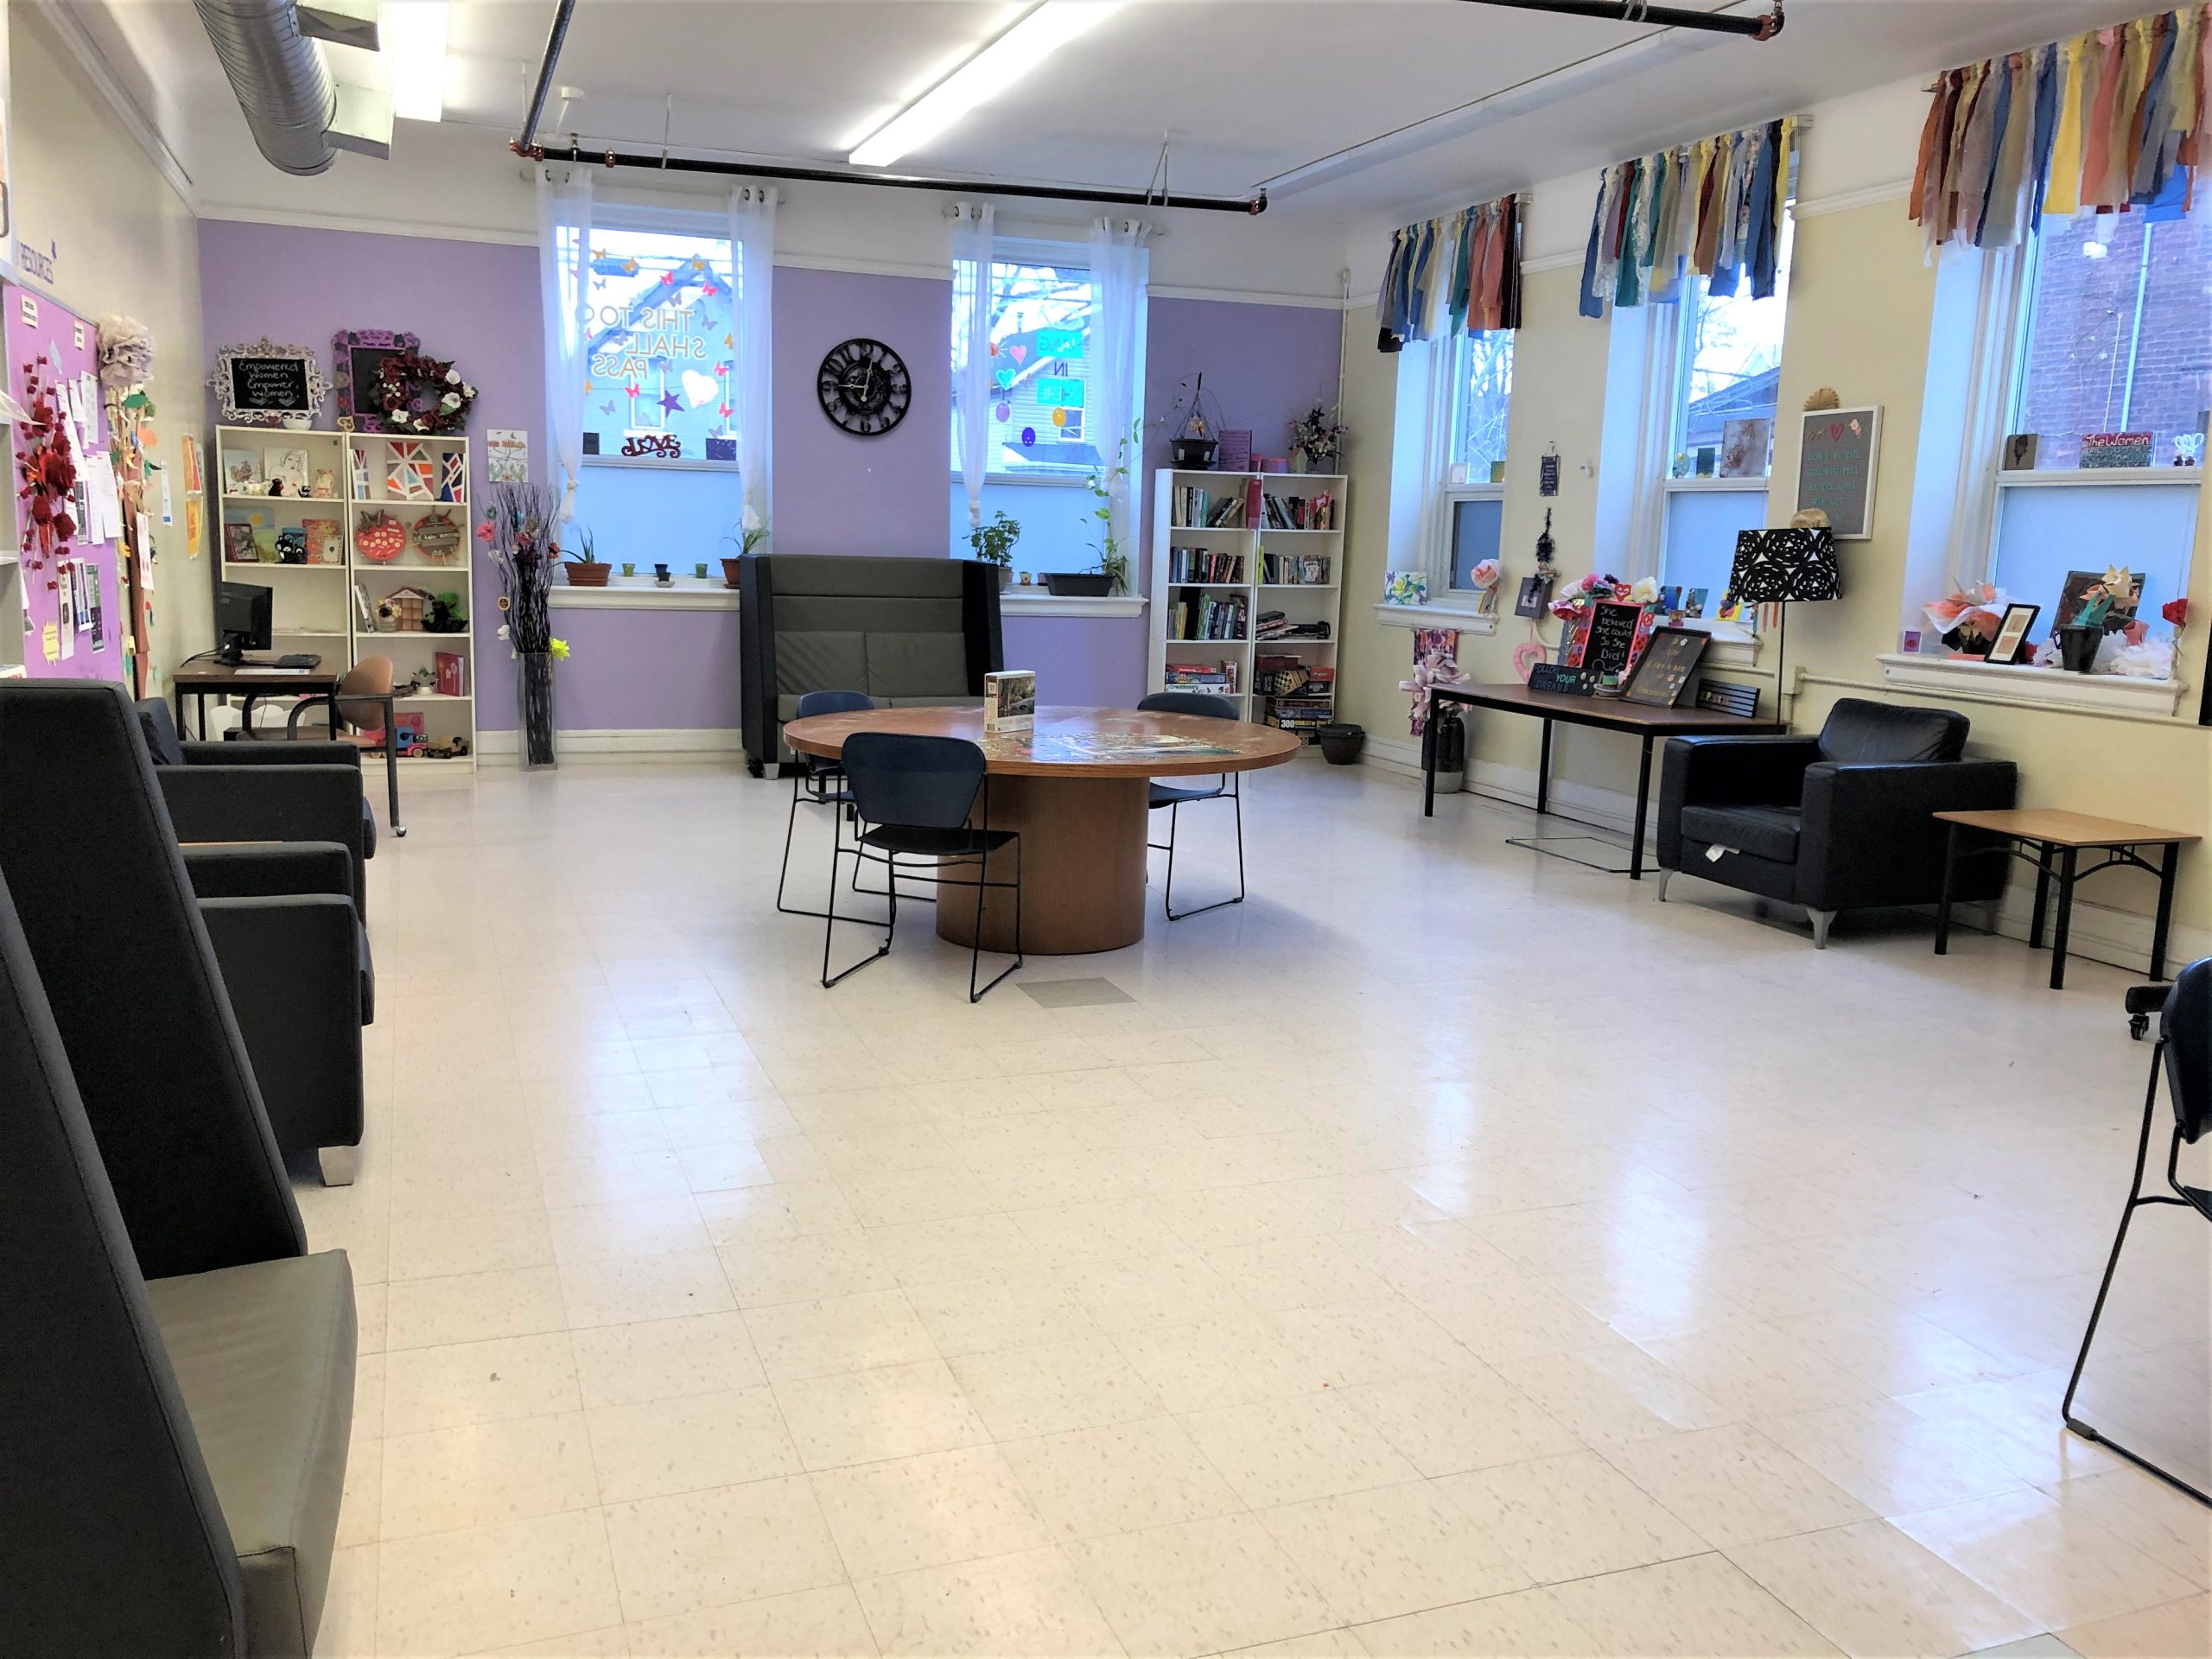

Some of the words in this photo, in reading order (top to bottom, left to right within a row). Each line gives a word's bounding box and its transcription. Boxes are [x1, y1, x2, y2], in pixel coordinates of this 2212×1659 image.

[238, 361, 298, 372] Empowered
[2106, 433, 2149, 447] Women
[620, 433, 682, 459] LOVE
[1556, 674, 1577, 684] YOUR
[1281, 719, 1295, 728] 300
